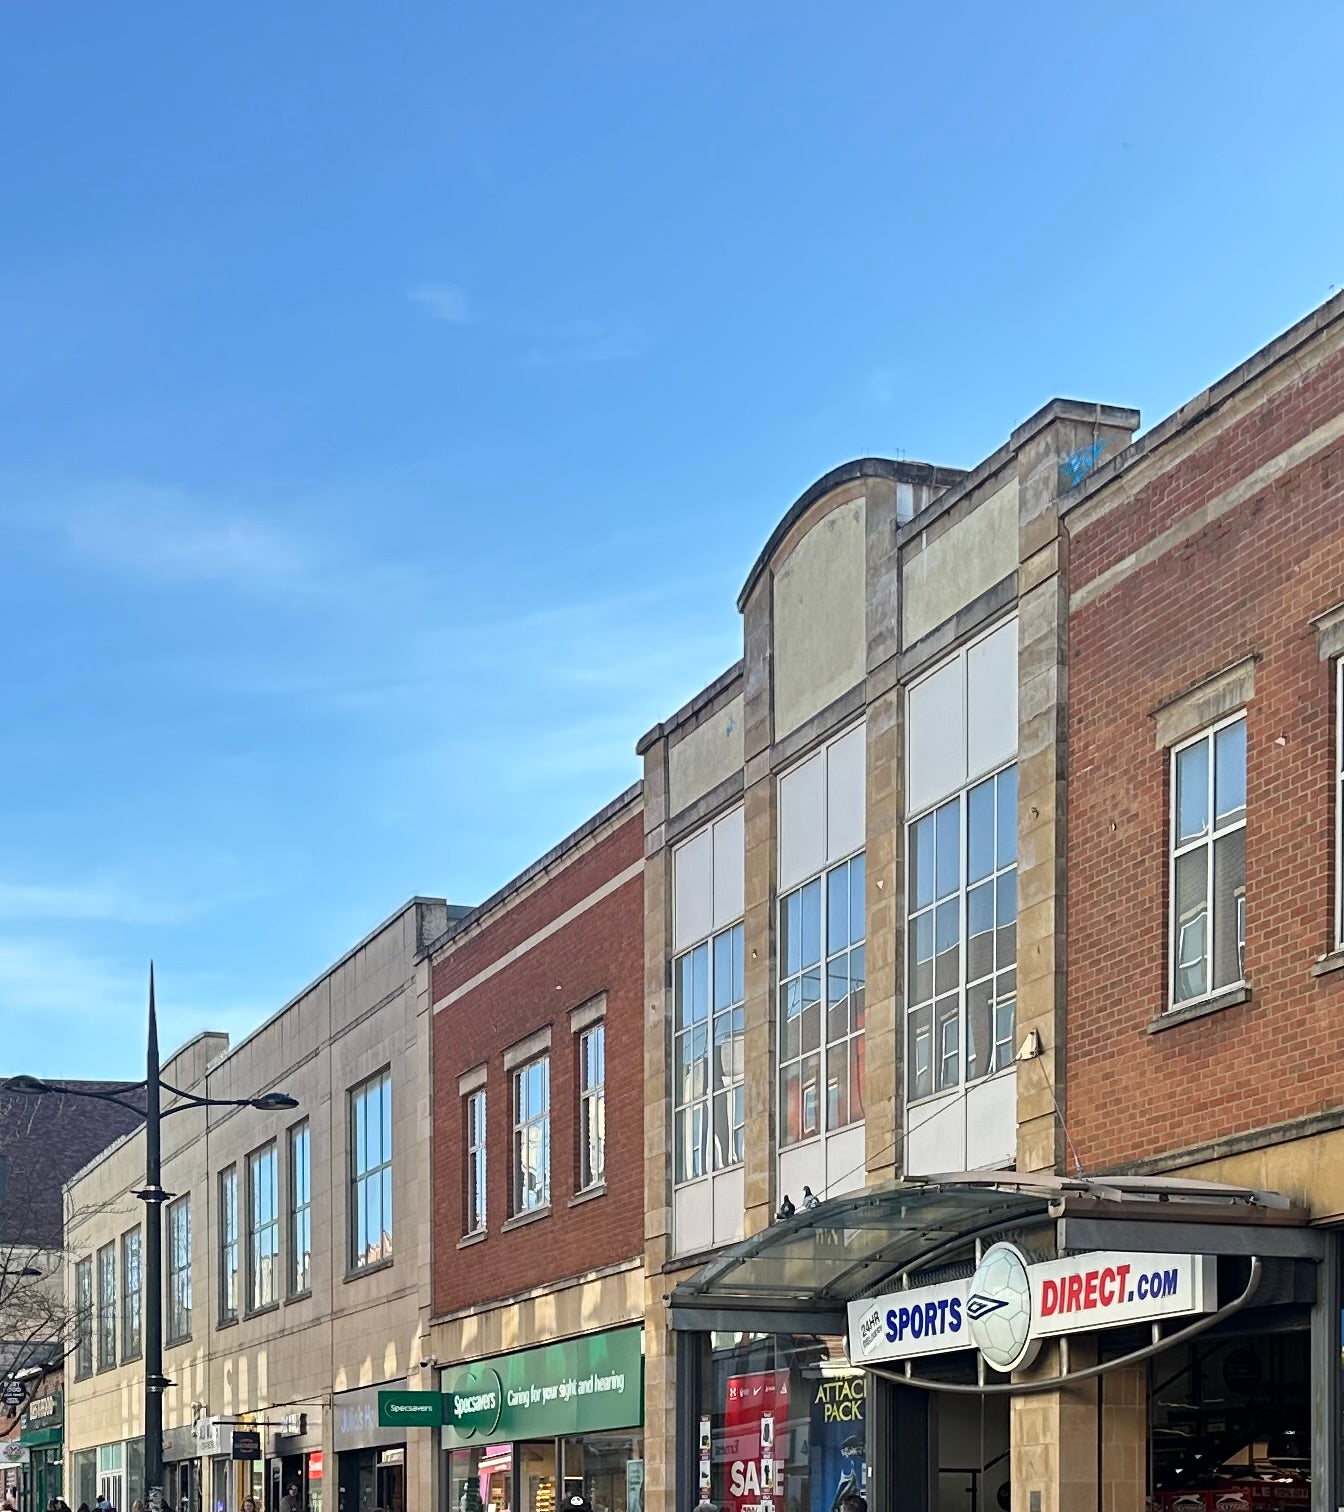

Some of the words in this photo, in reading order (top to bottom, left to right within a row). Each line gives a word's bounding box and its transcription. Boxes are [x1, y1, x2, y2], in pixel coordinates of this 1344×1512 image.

[885, 1297, 962, 1343] SPORTS
[1041, 1264, 1179, 1318] DIRECT.COM
[861, 1310, 880, 1337] 24HR
[390, 1404, 433, 1413] Specsavers
[454, 1392, 496, 1418] Specsavers
[507, 1387, 530, 1408] Caring
[531, 1384, 542, 1403] for
[542, 1384, 559, 1405] your
[558, 1377, 577, 1401] sight
[578, 1373, 593, 1395] and
[594, 1370, 625, 1393] hearing
[824, 1400, 863, 1423] PACK
[729, 1461, 785, 1497] SAE
